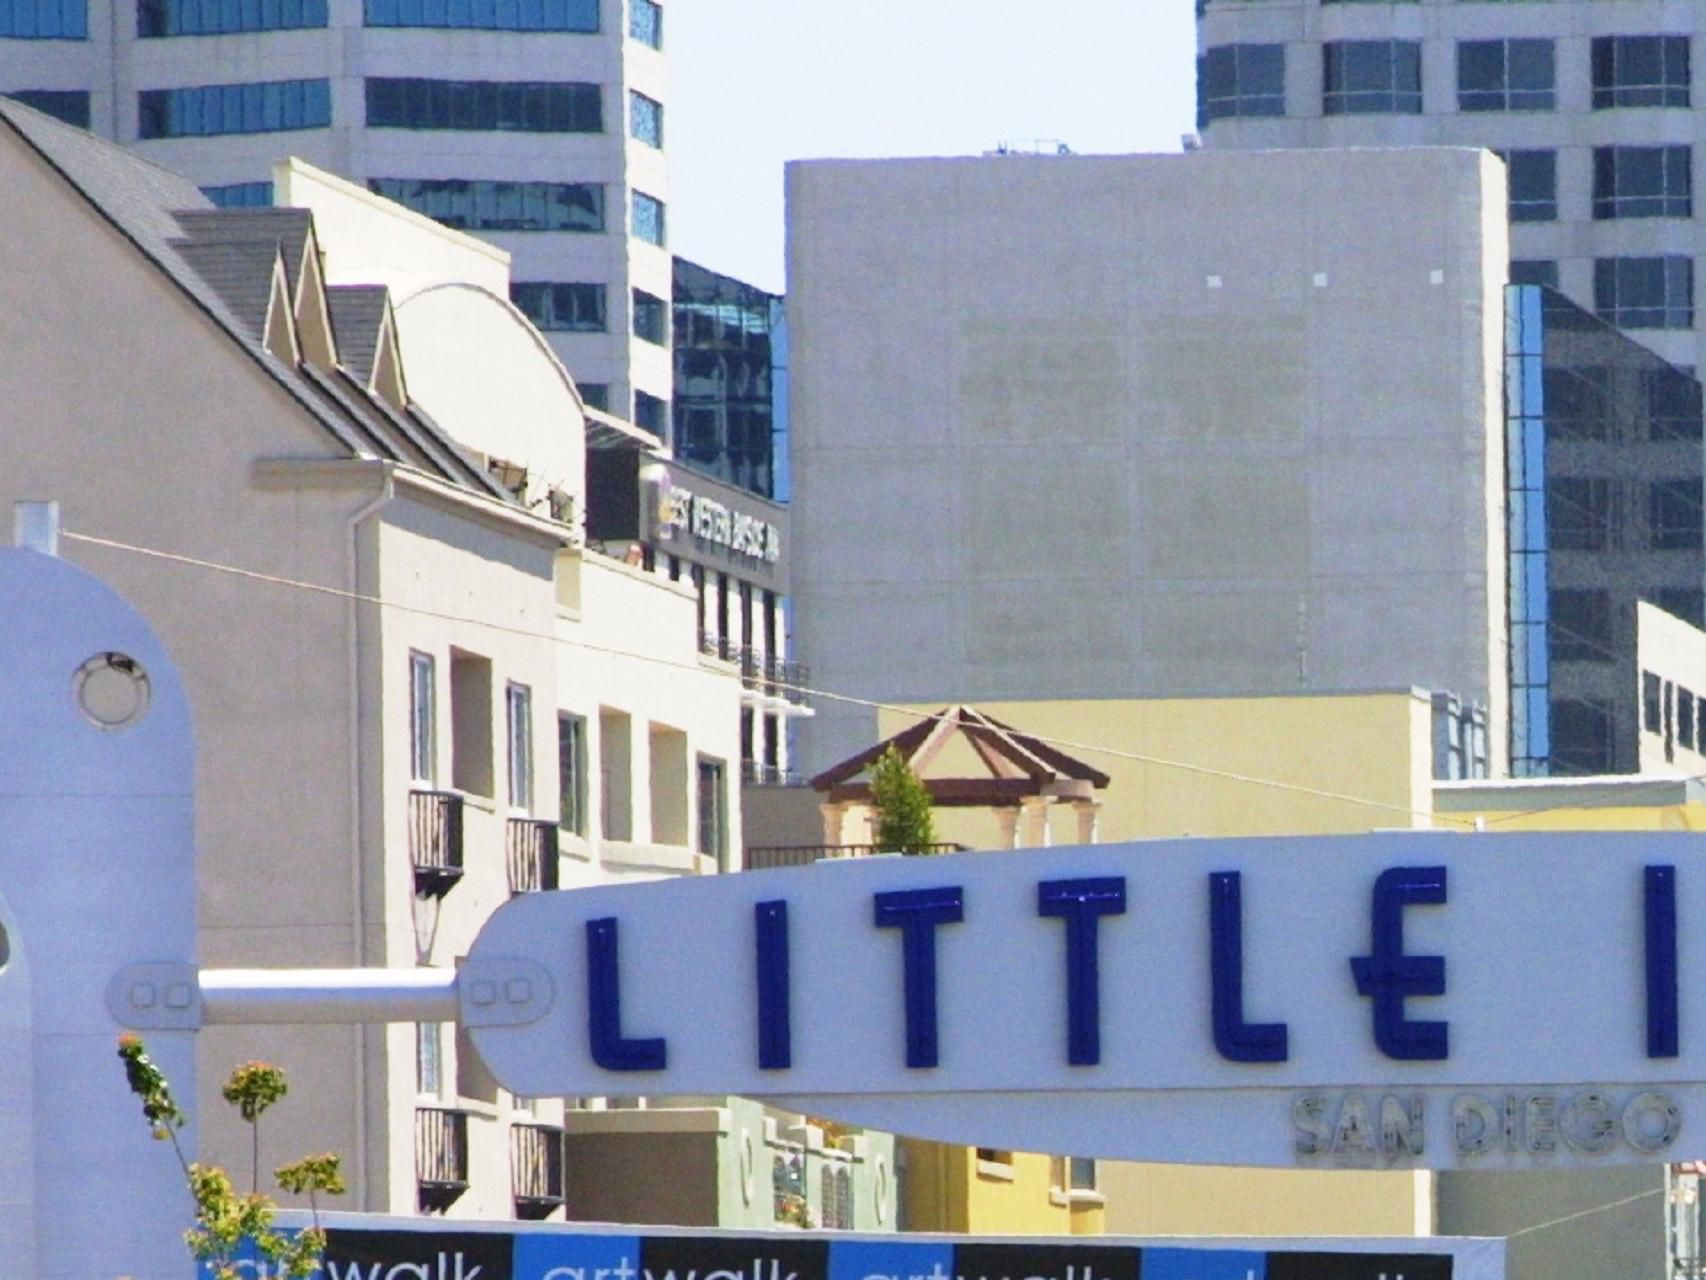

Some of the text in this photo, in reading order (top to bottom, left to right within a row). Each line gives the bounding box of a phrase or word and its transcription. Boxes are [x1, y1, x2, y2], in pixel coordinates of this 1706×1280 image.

[586, 865, 1448, 1071] LITTLE
[1291, 1091, 1681, 1155] SAN DIEGO
